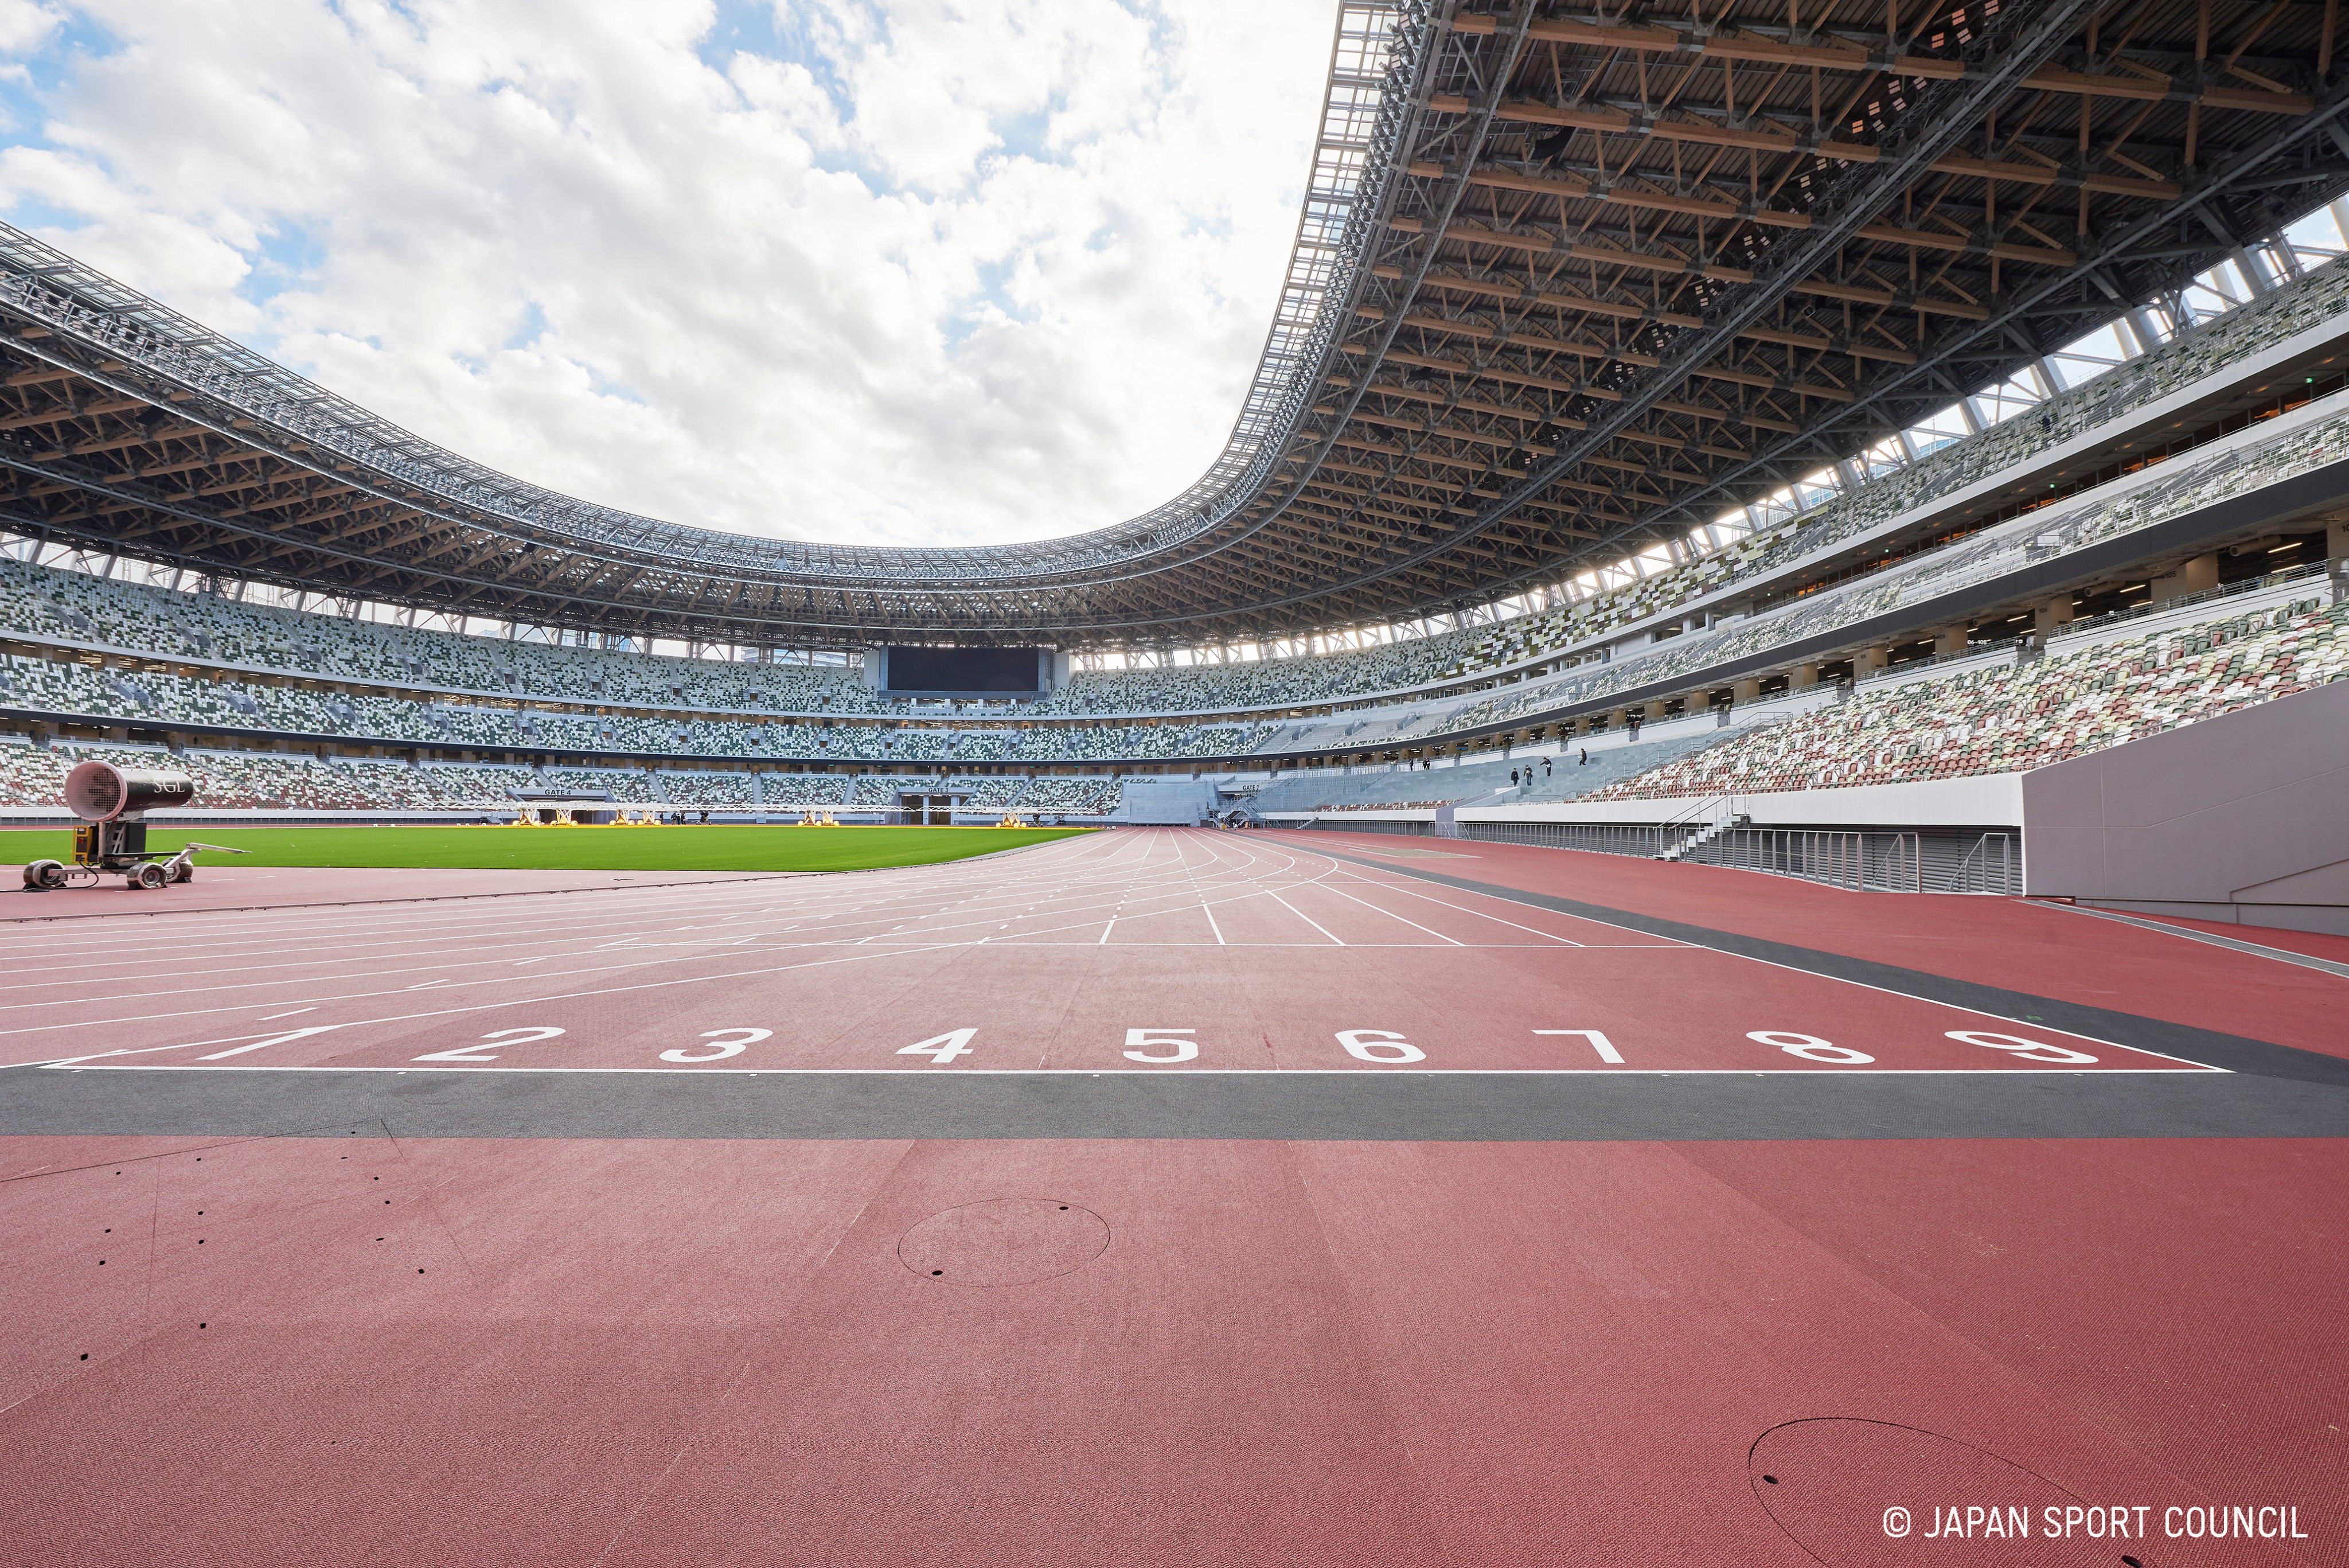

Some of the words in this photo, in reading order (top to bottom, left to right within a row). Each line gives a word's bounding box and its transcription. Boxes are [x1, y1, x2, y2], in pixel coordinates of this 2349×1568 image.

[153, 778, 185, 793] SGL
[194, 1027, 341, 1060] 1
[409, 1027, 566, 1061] 2
[659, 1028, 773, 1062] 3
[895, 1028, 978, 1063] 4
[1123, 1029, 1199, 1063] 5
[1335, 1029, 1426, 1063] 6
[1532, 1030, 1625, 1063] 7
[1746, 1031, 1875, 1063] 8
[1945, 1031, 2098, 1063] 9
